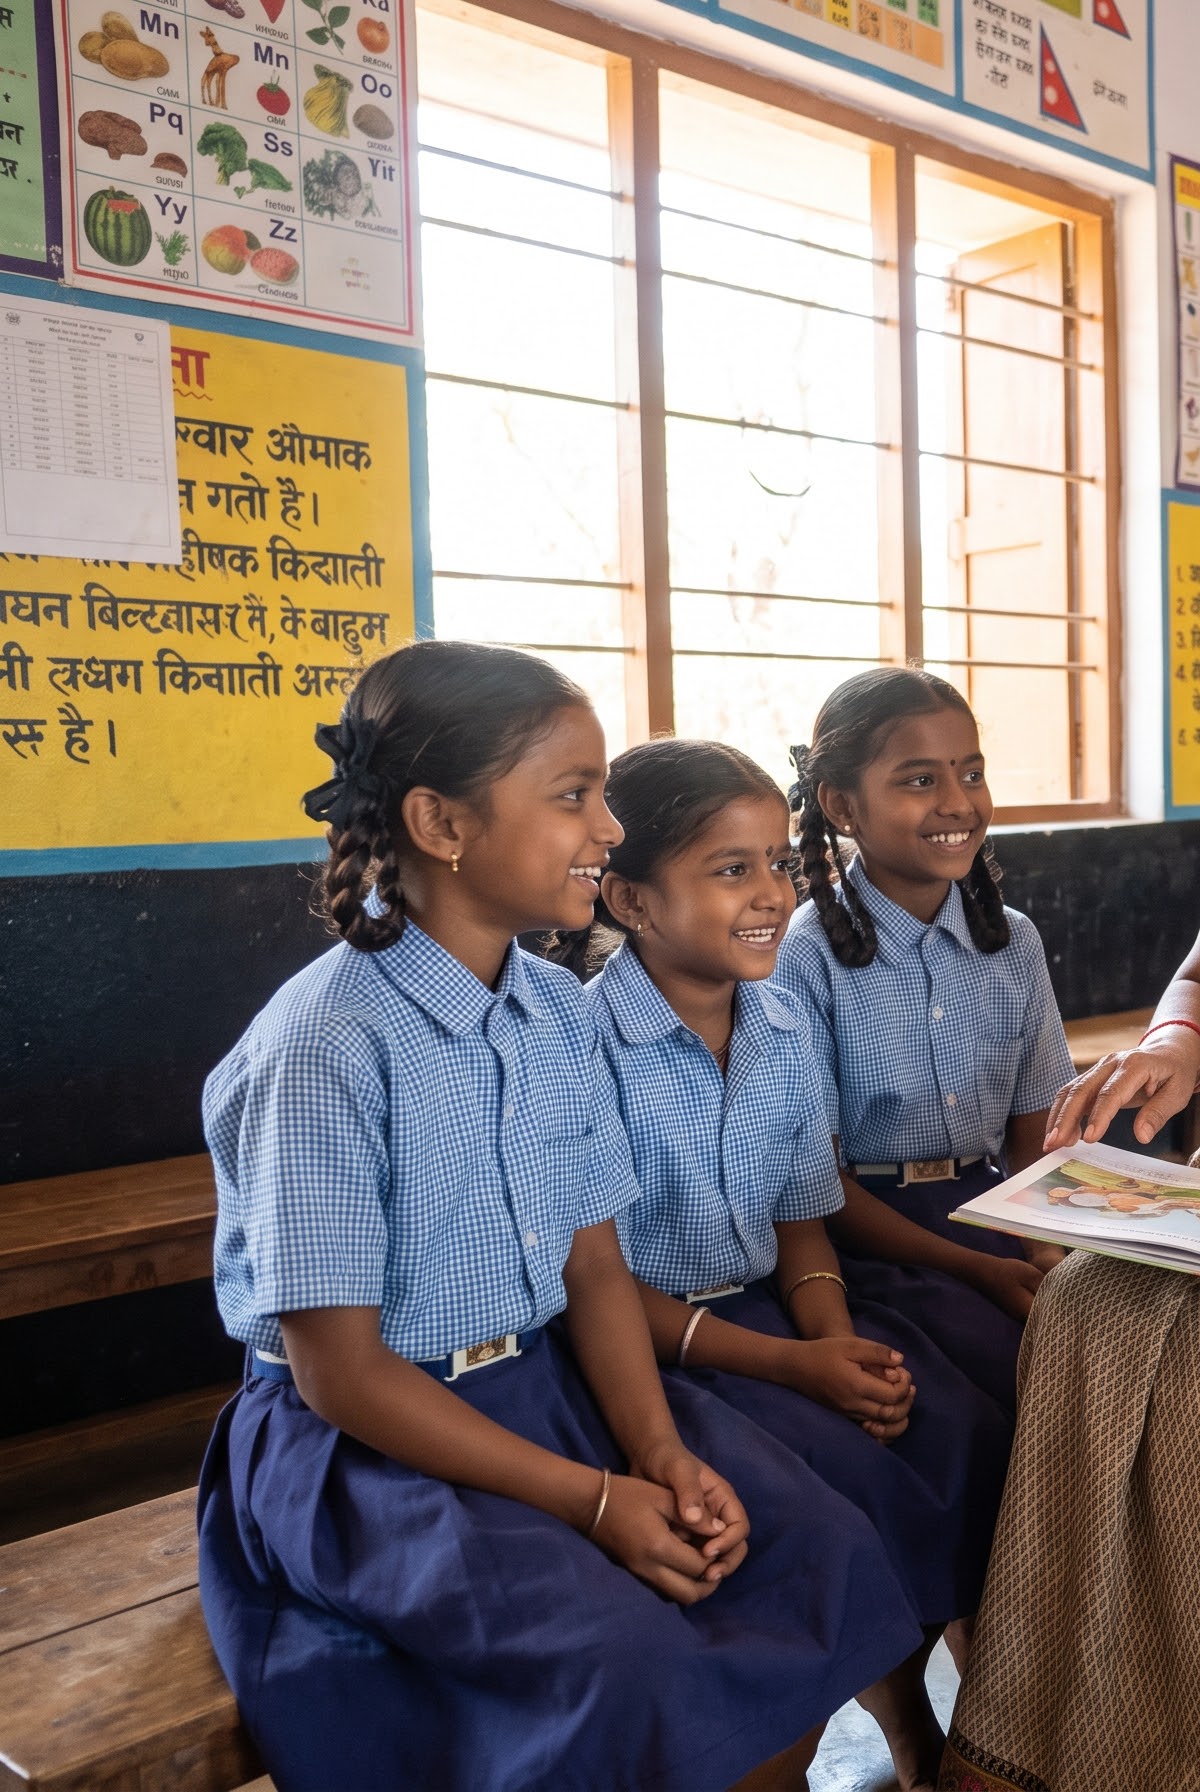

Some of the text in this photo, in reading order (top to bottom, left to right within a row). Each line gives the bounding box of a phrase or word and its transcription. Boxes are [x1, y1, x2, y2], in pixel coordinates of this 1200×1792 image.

[139, 9, 180, 40] Mn
[253, 41, 290, 70] Mn
[361, 73, 392, 98] Oo
[149, 101, 184, 136] Pq
[263, 131, 294, 157] Ss
[154, 193, 188, 225] Yy
[269, 219, 298, 243] Zz
